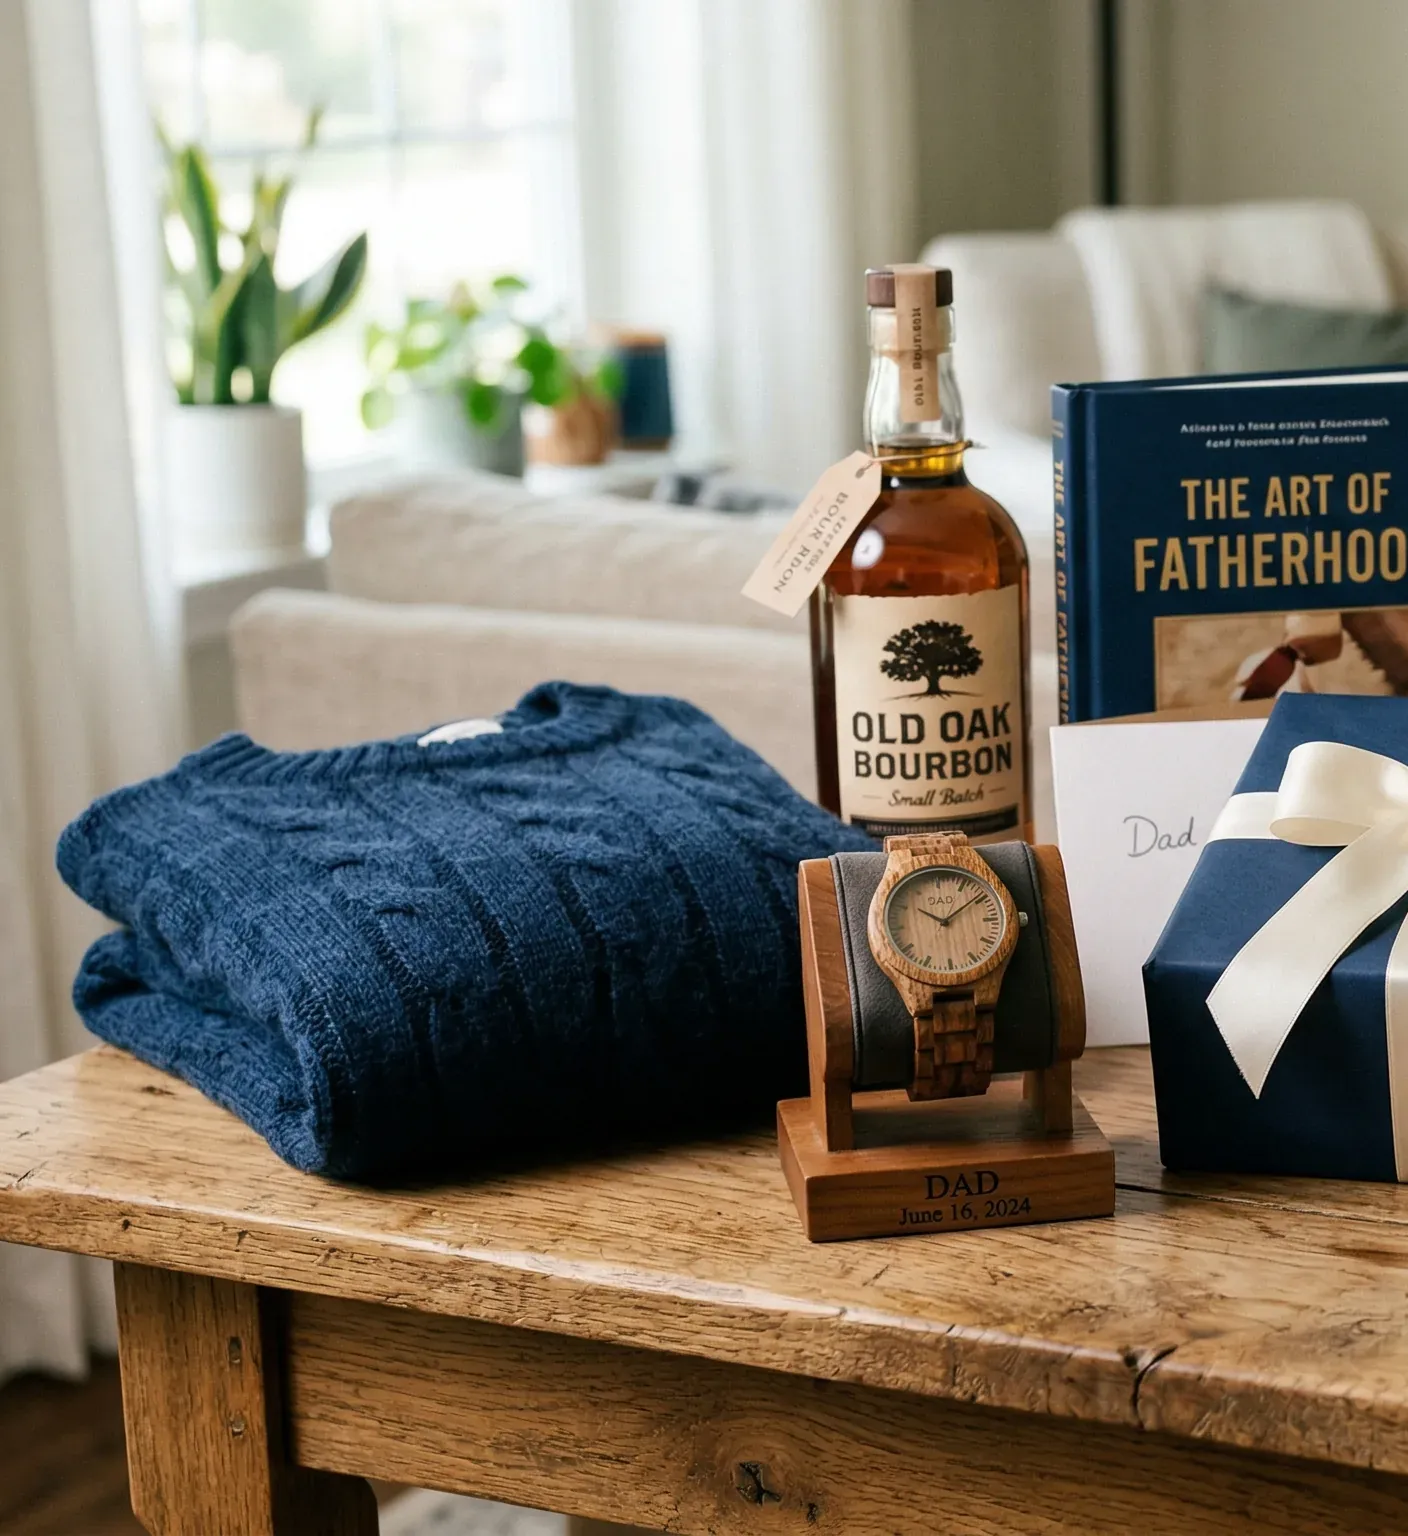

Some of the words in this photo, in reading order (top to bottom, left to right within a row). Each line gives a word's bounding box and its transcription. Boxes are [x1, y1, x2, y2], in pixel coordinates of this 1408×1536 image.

[1180, 477, 1251, 521] THE
[1263, 473, 1335, 518] ART
[1346, 471, 1392, 515] OF
[852, 711, 926, 744] OLD
[940, 702, 1012, 743] OAK
[853, 741, 1013, 780] BOURBON
[888, 787, 935, 807] Small
[938, 783, 985, 807] Batch
[1122, 815, 1198, 858] Dad
[927, 895, 954, 906] DAD
[924, 1170, 1000, 1200] DAD
[898, 1207, 944, 1226] June
[950, 1202, 979, 1222] 16,
[984, 1197, 1032, 1218] 2024
